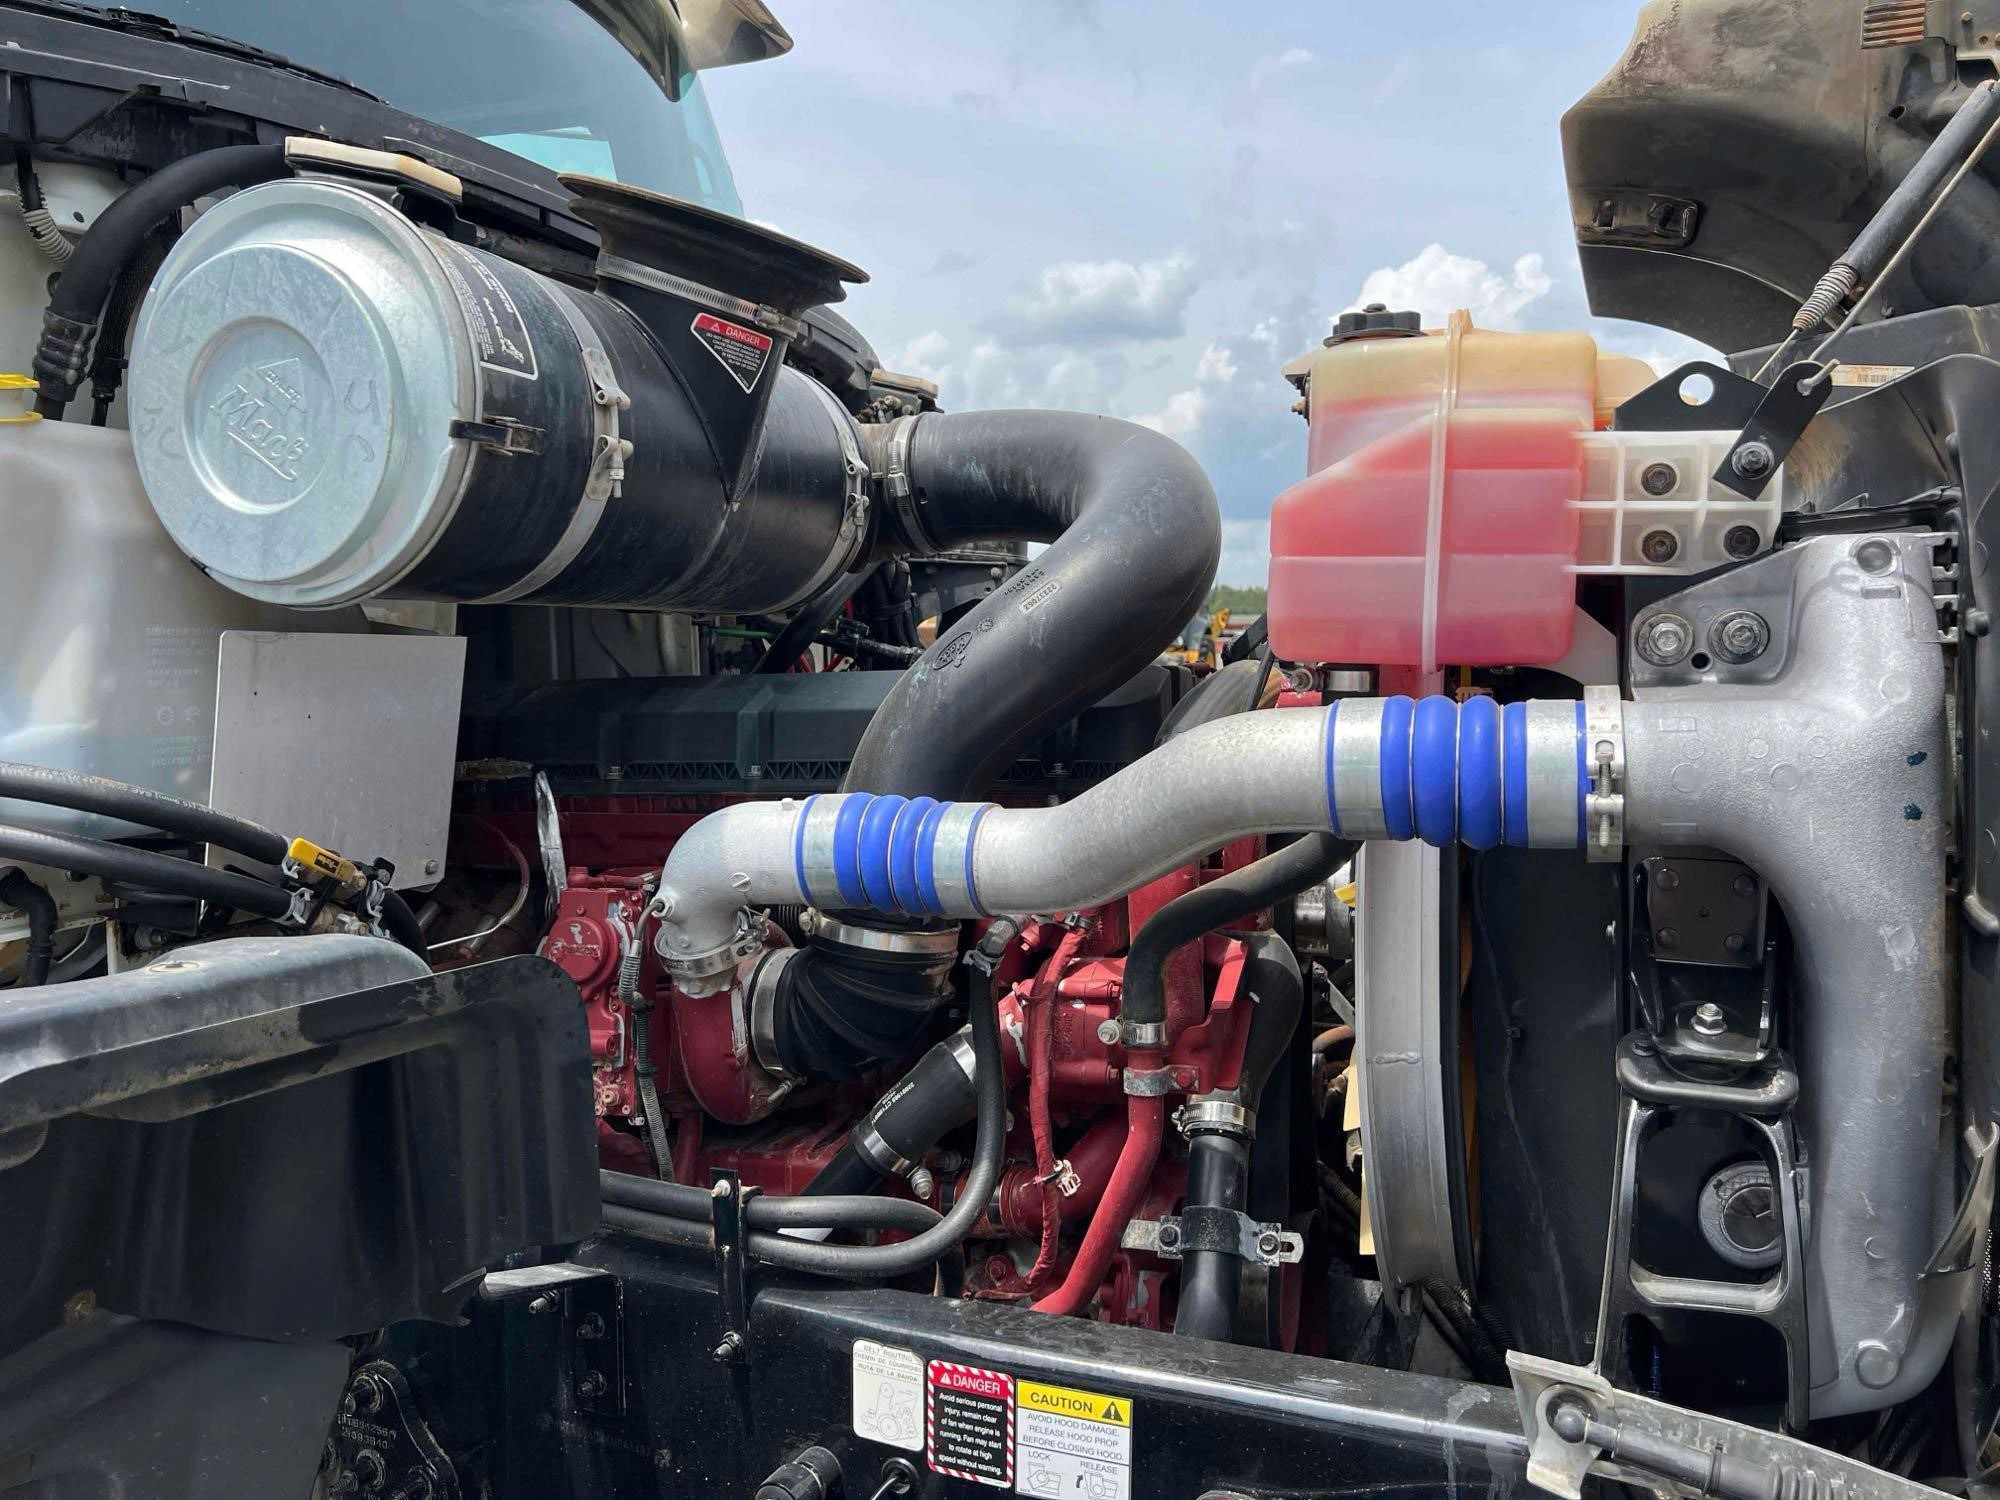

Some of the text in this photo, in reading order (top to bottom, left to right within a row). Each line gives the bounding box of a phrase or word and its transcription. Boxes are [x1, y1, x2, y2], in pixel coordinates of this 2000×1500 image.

[725, 326, 760, 346] DANGER
[209, 384, 307, 480] Mack
[953, 1374, 1001, 1395] DANGER
[939, 1392, 1003, 1413] Avoid serious personal
[1030, 1391, 1093, 1414] CAUTION
[961, 1410, 982, 1421] remain
[982, 1414, 998, 1424] clear
[1027, 1412, 1053, 1424] AVOID
[1054, 1418, 1080, 1430] HOOD
[948, 1419, 957, 1427] fan
[957, 1421, 974, 1431] when
[974, 1426, 994, 1436] engine
[1029, 1424, 1119, 1448] RELEASE HOOD PROP
[948, 1443, 993, 1461] to rotate at high
[962, 1434, 975, 1443] Fan
[974, 1438, 988, 1447] may
[988, 1440, 1002, 1450] start
[1022, 1434, 1125, 1462] BEFORE CLOSING HOOD.
[938, 1453, 1003, 1476] speed without warning.
[1028, 1450, 1052, 1461] LOCK
[1079, 1460, 1119, 1475] RELEASE
